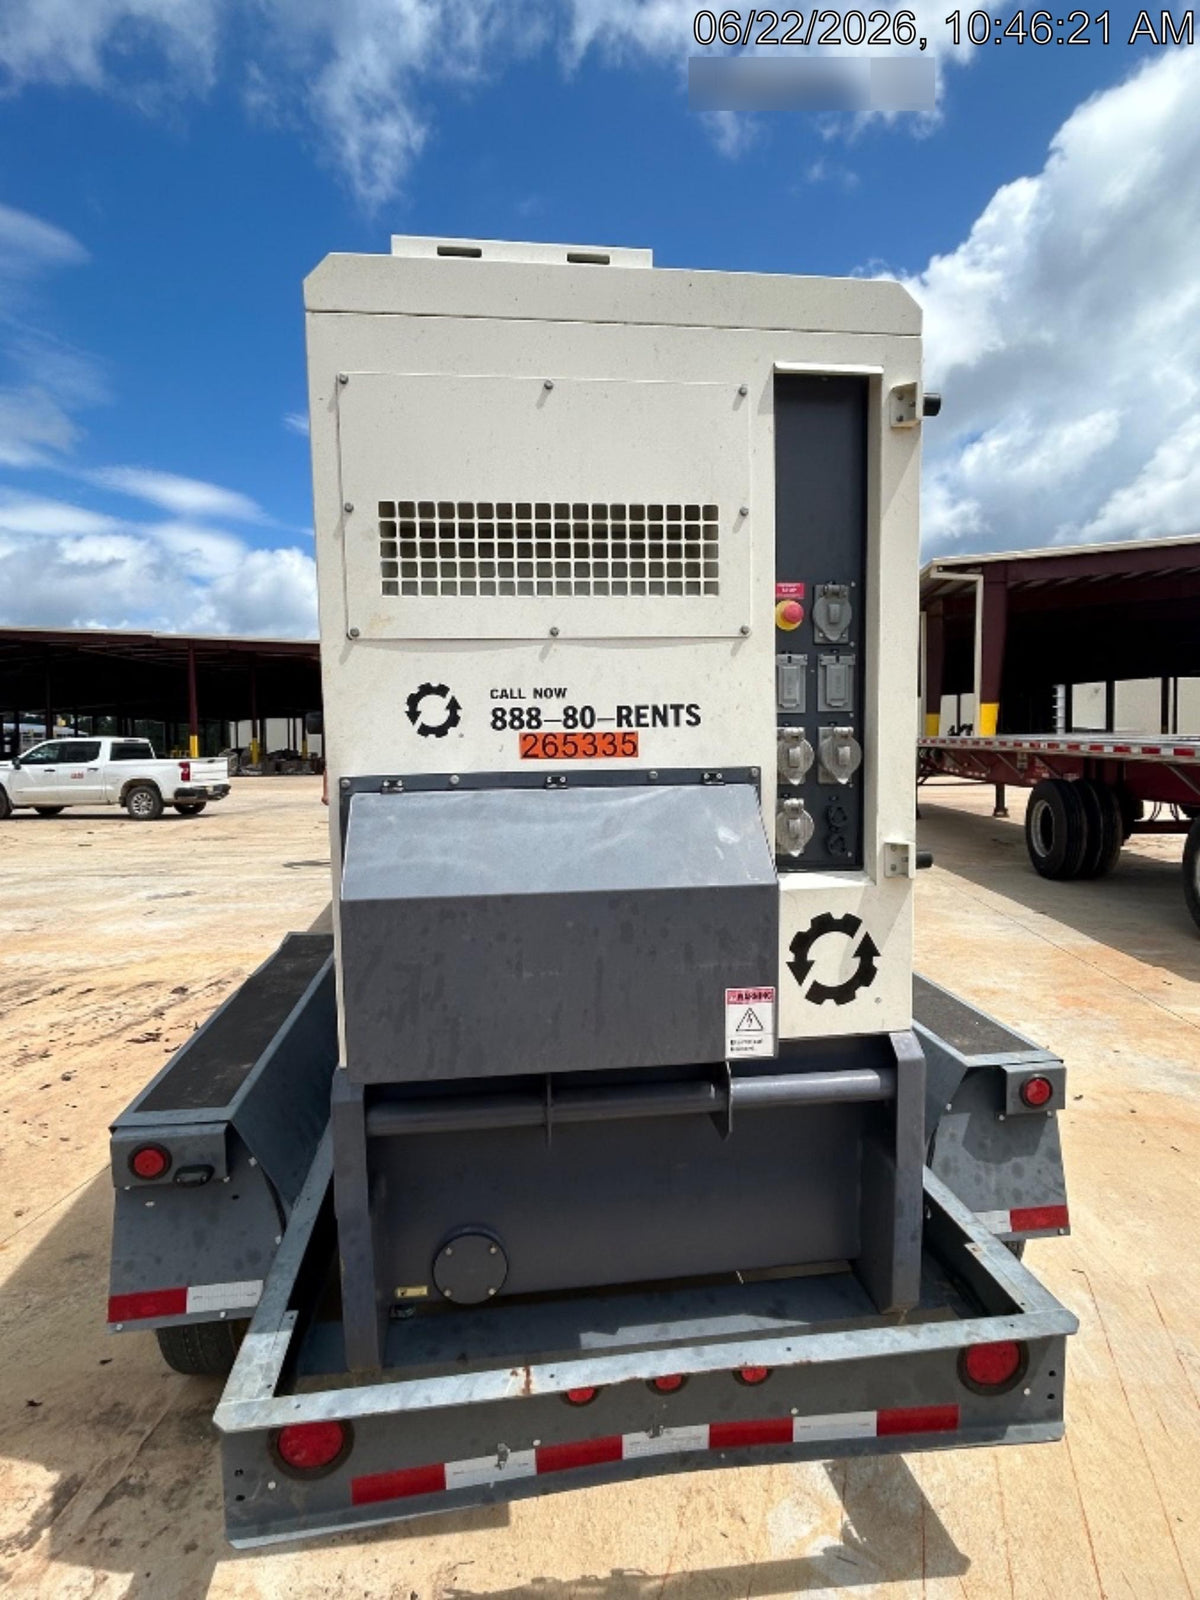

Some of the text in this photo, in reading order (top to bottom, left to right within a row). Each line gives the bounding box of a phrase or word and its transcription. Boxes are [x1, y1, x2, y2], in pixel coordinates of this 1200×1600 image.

[490, 688, 568, 700] CALL NOW
[522, 732, 637, 758] 265335
